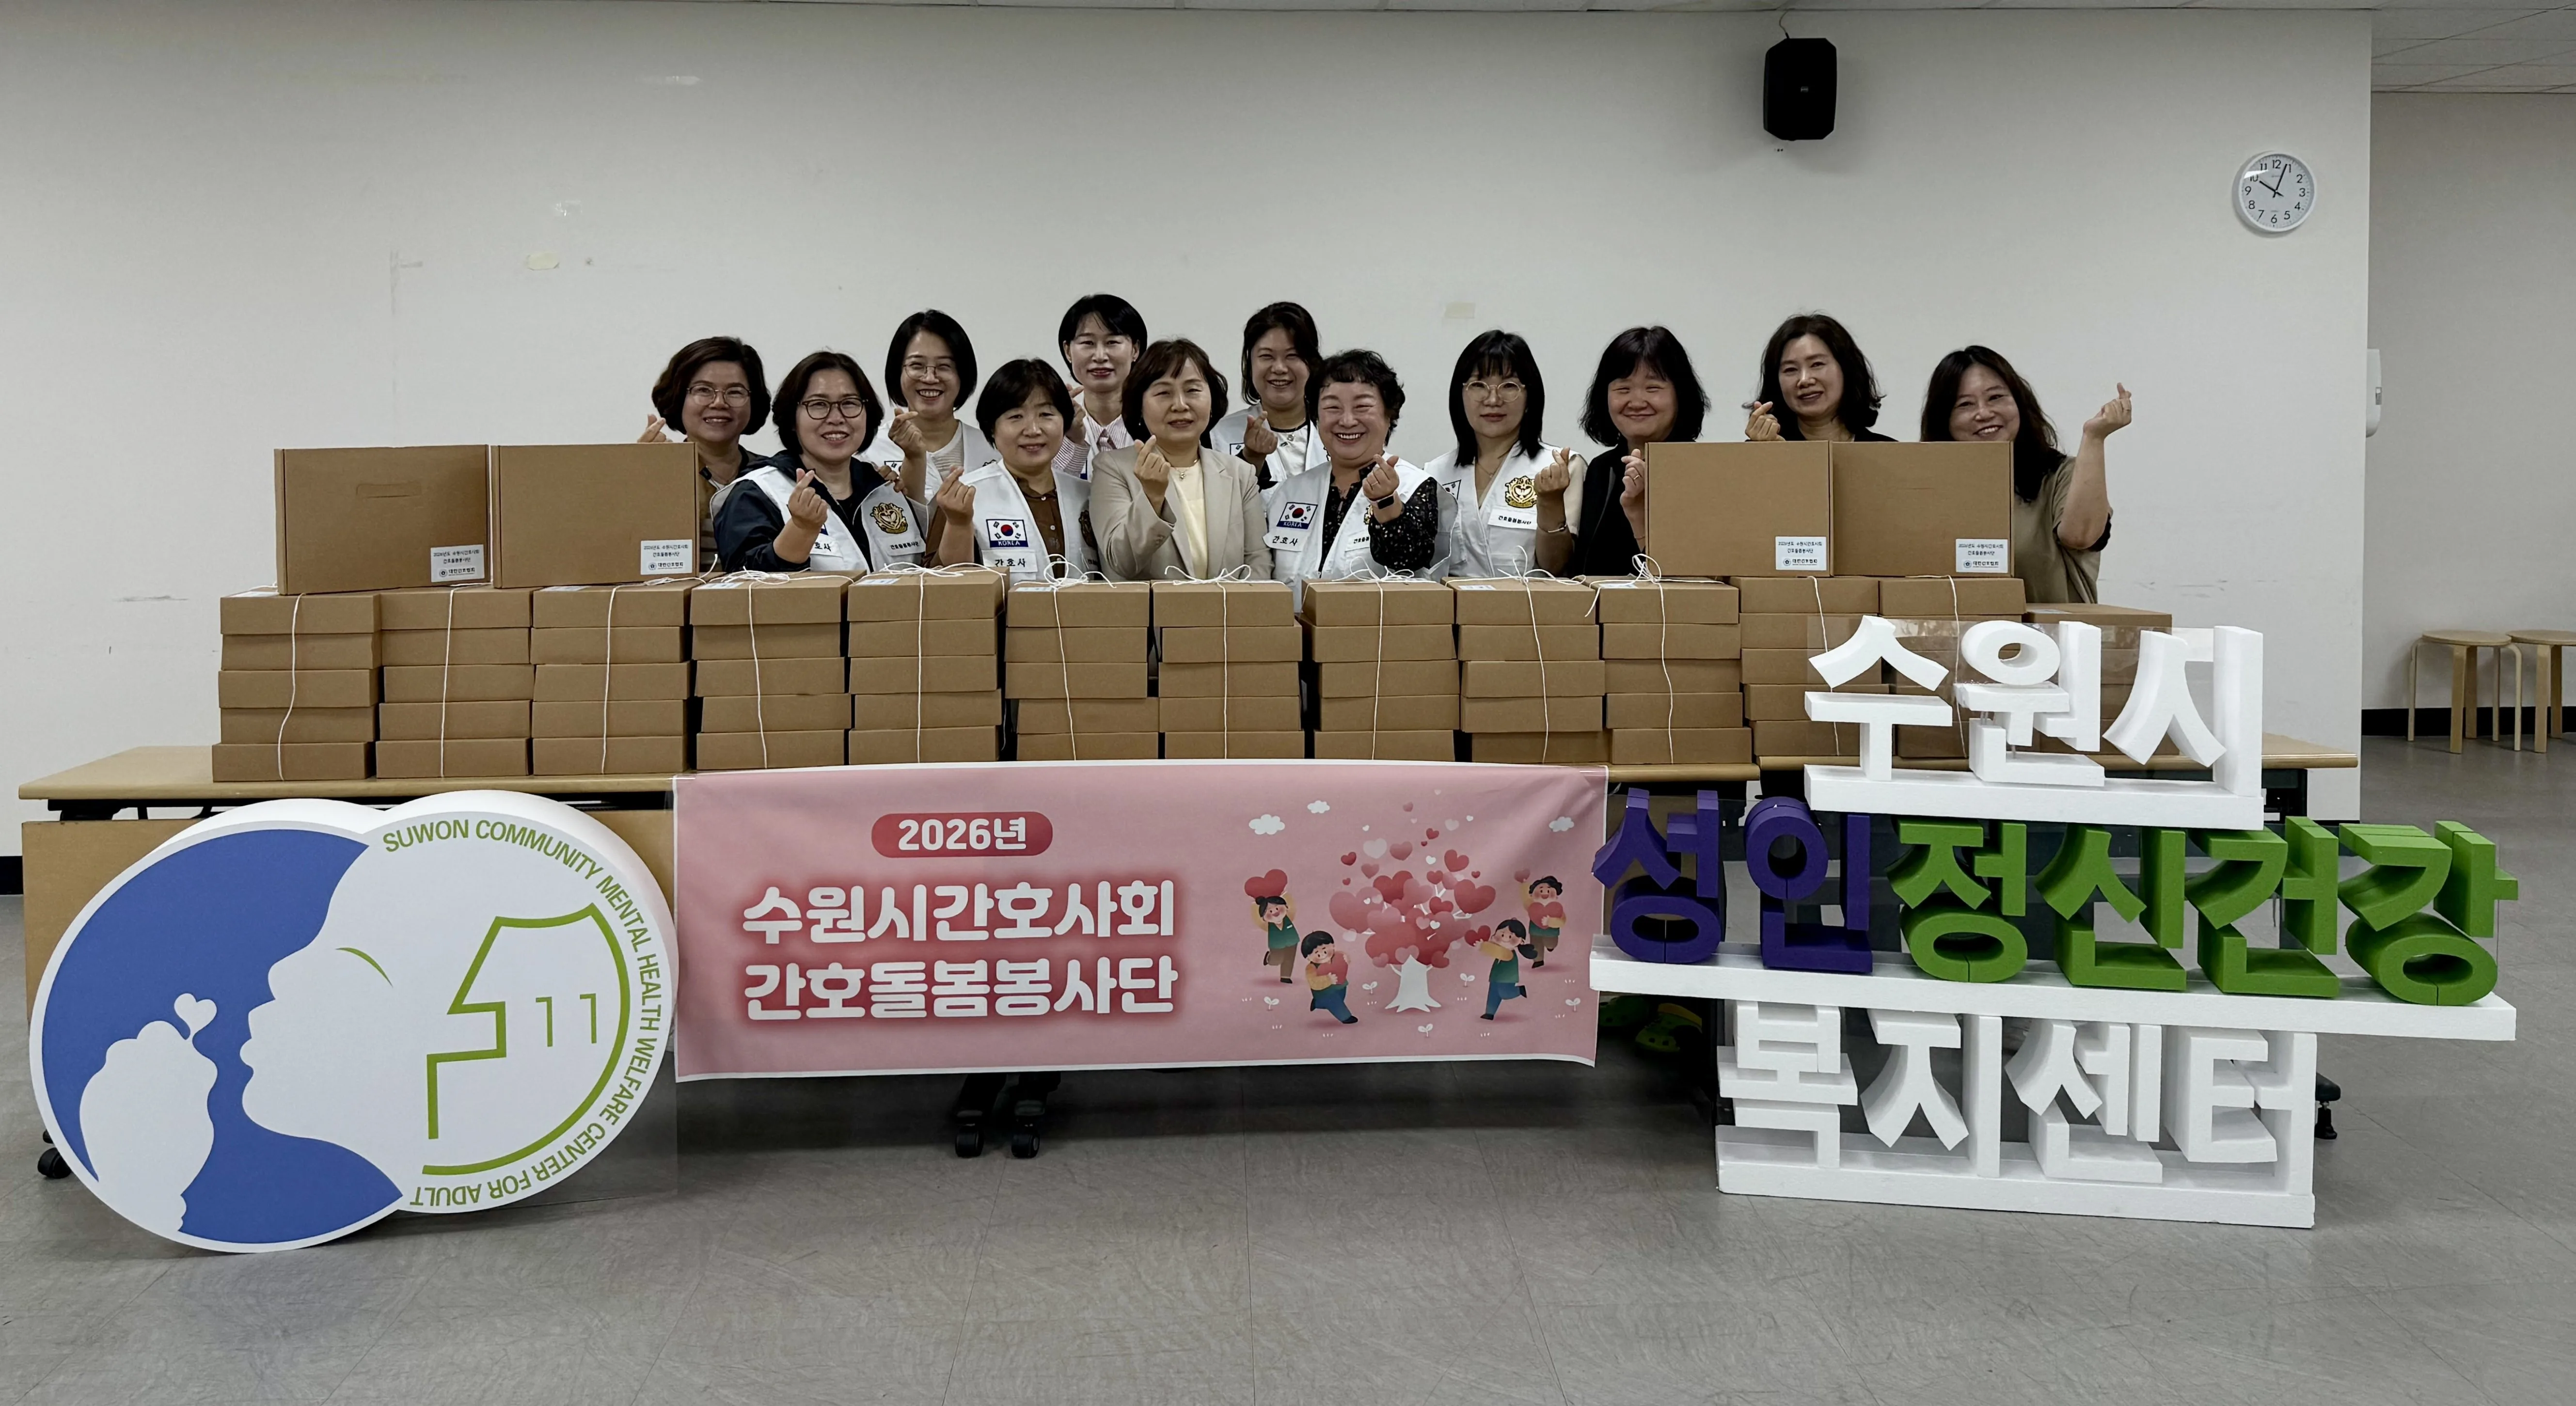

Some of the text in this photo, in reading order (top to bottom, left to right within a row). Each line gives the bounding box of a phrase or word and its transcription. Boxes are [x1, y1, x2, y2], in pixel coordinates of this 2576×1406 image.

[2272, 159, 2281, 169] 12
[2288, 164, 2292, 173] 1
[2296, 174, 2303, 183] 2
[2245, 186, 2251, 195] 9
[2299, 188, 2306, 197] 3
[2248, 200, 2255, 209] 8
[2258, 210, 2264, 219] 7
[2271, 214, 2277, 223] 6
[2284, 211, 2290, 220] 5
[1272, 536, 1298, 546] 간호사
[814, 542, 831, 552] 호사
[995, 558, 1026, 568] 간호사
[1804, 615, 2263, 797] 수원시
[898, 817, 1027, 851] 2026년
[743, 880, 1174, 944] 수원시간호사회
[743, 955, 1179, 1020] 간호돌봄봉사단
[383, 819, 662, 1206] SUWON COMMUNITY MENTAL HEALTH WELFARE CENTER FOR ADULT
[1717, 1000, 2317, 1196] 복지센터
